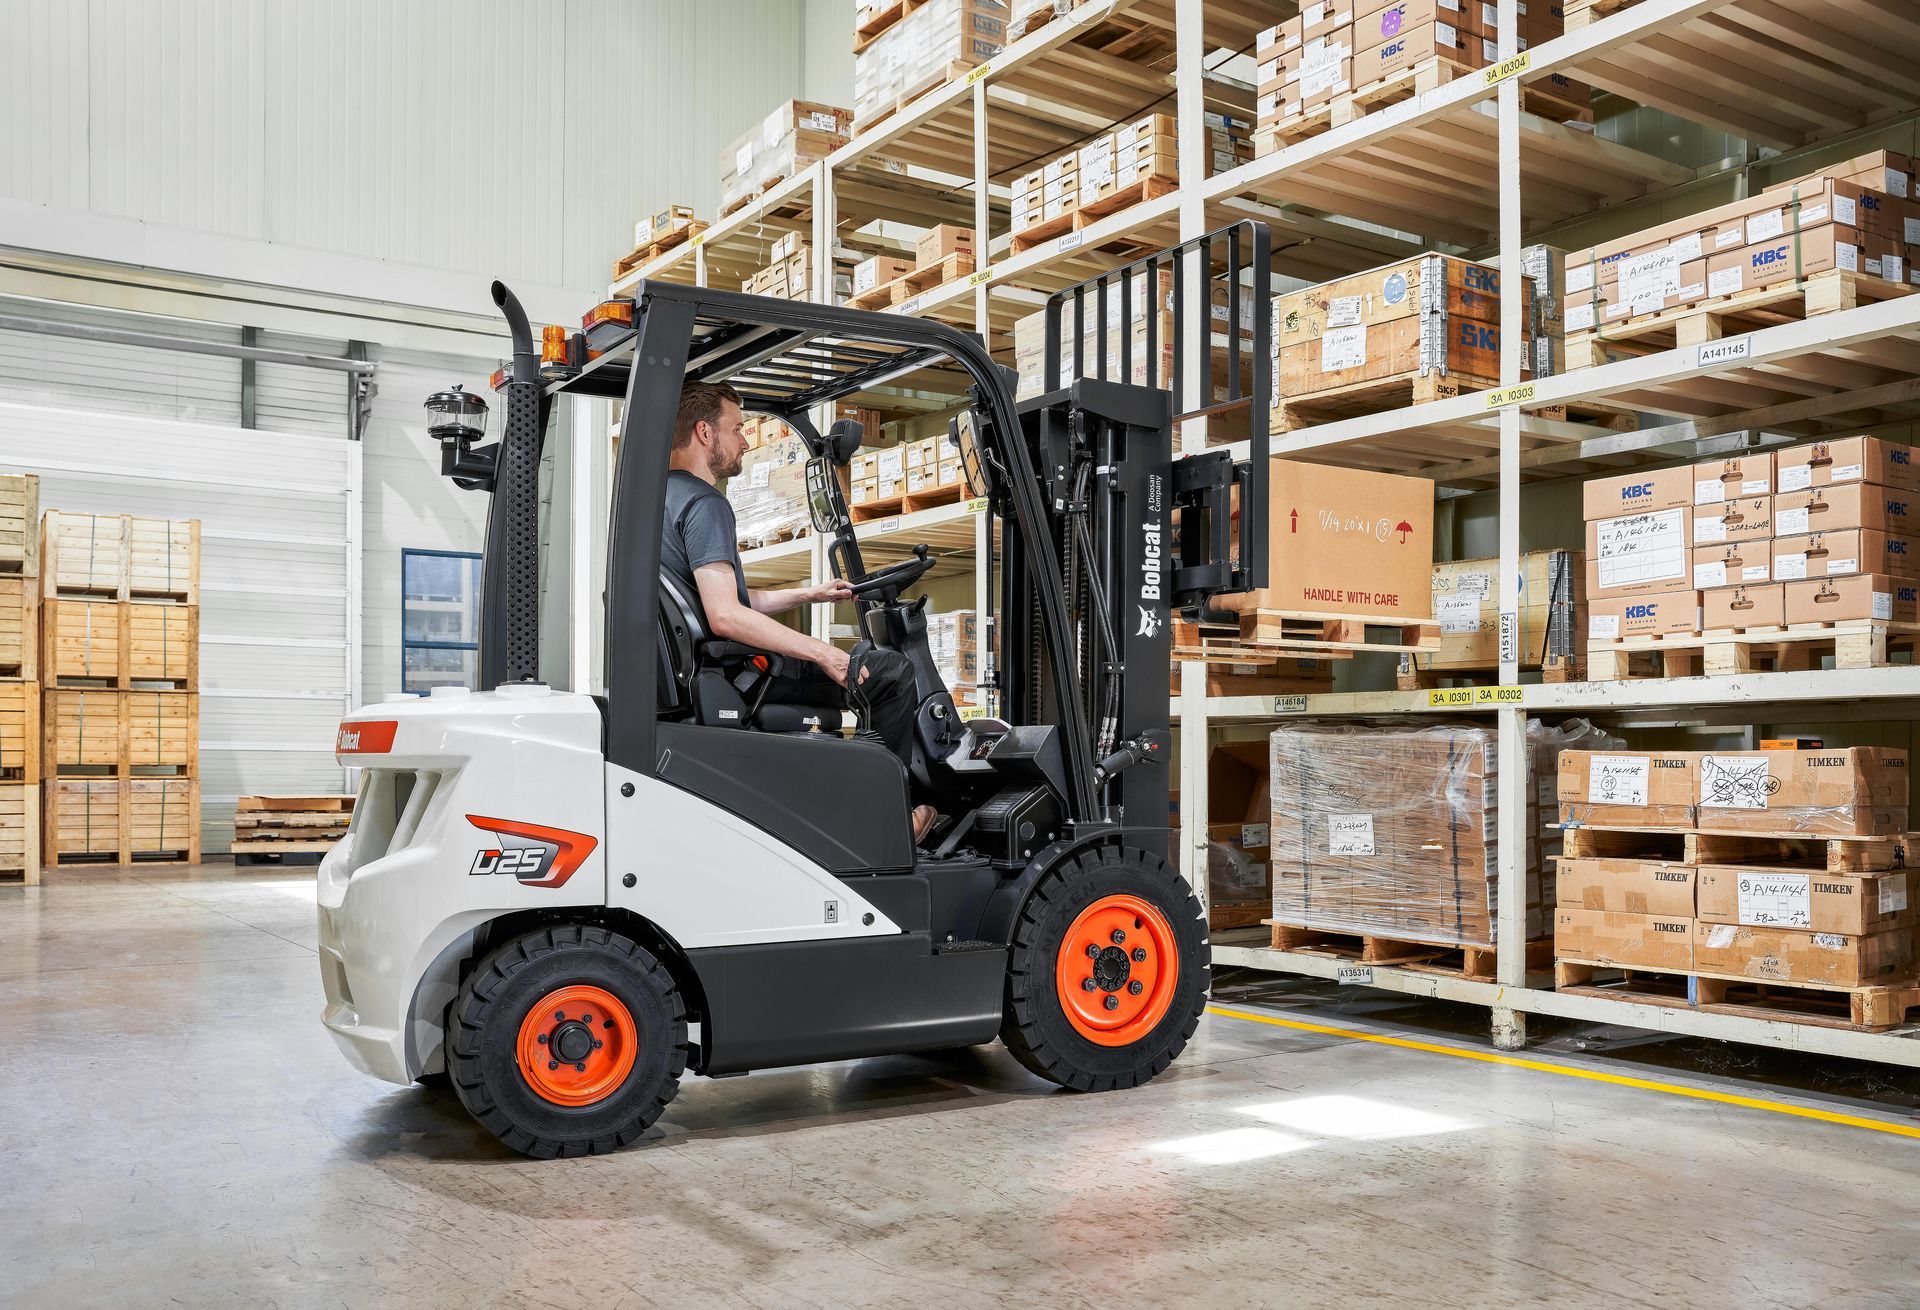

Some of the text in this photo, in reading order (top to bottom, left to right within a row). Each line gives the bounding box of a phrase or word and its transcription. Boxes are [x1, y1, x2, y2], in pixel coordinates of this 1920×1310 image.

[1381, 40, 1405, 59] KBC
[1486, 70, 1498, 82] 3A
[1859, 194, 1880, 211] KBC
[1752, 244, 1787, 267] KBC
[1464, 265, 1500, 294] SK
[1461, 323, 1500, 352] SK
[1702, 344, 1745, 360] A141145
[1490, 393, 1503, 405] 3A
[1890, 449, 1909, 465] KBC
[1154, 475, 1163, 512] Company
[1622, 482, 1652, 499] KBC
[1887, 499, 1907, 516] KBC
[1887, 539, 1908, 555] KBC
[1141, 523, 1161, 600] Bobcat
[1304, 587, 1399, 606] HANDLE WITH CARE
[1898, 587, 1917, 602] KBC
[1625, 604, 1656, 619] KBC
[1501, 615, 1509, 659] A151872
[1276, 697, 1305, 706] A146184
[1432, 692, 1444, 703] 3A
[1480, 689, 1492, 700] 3A
[1653, 759, 1686, 769] TIMKEN
[1807, 757, 1846, 767] TIMKEN
[1881, 758, 1905, 768] TIMKEN
[469, 847, 547, 875] D25
[1654, 872, 1688, 883] TIMKEN
[1813, 882, 1853, 895] TIMKEN
[1653, 922, 1687, 933] TIMKEN
